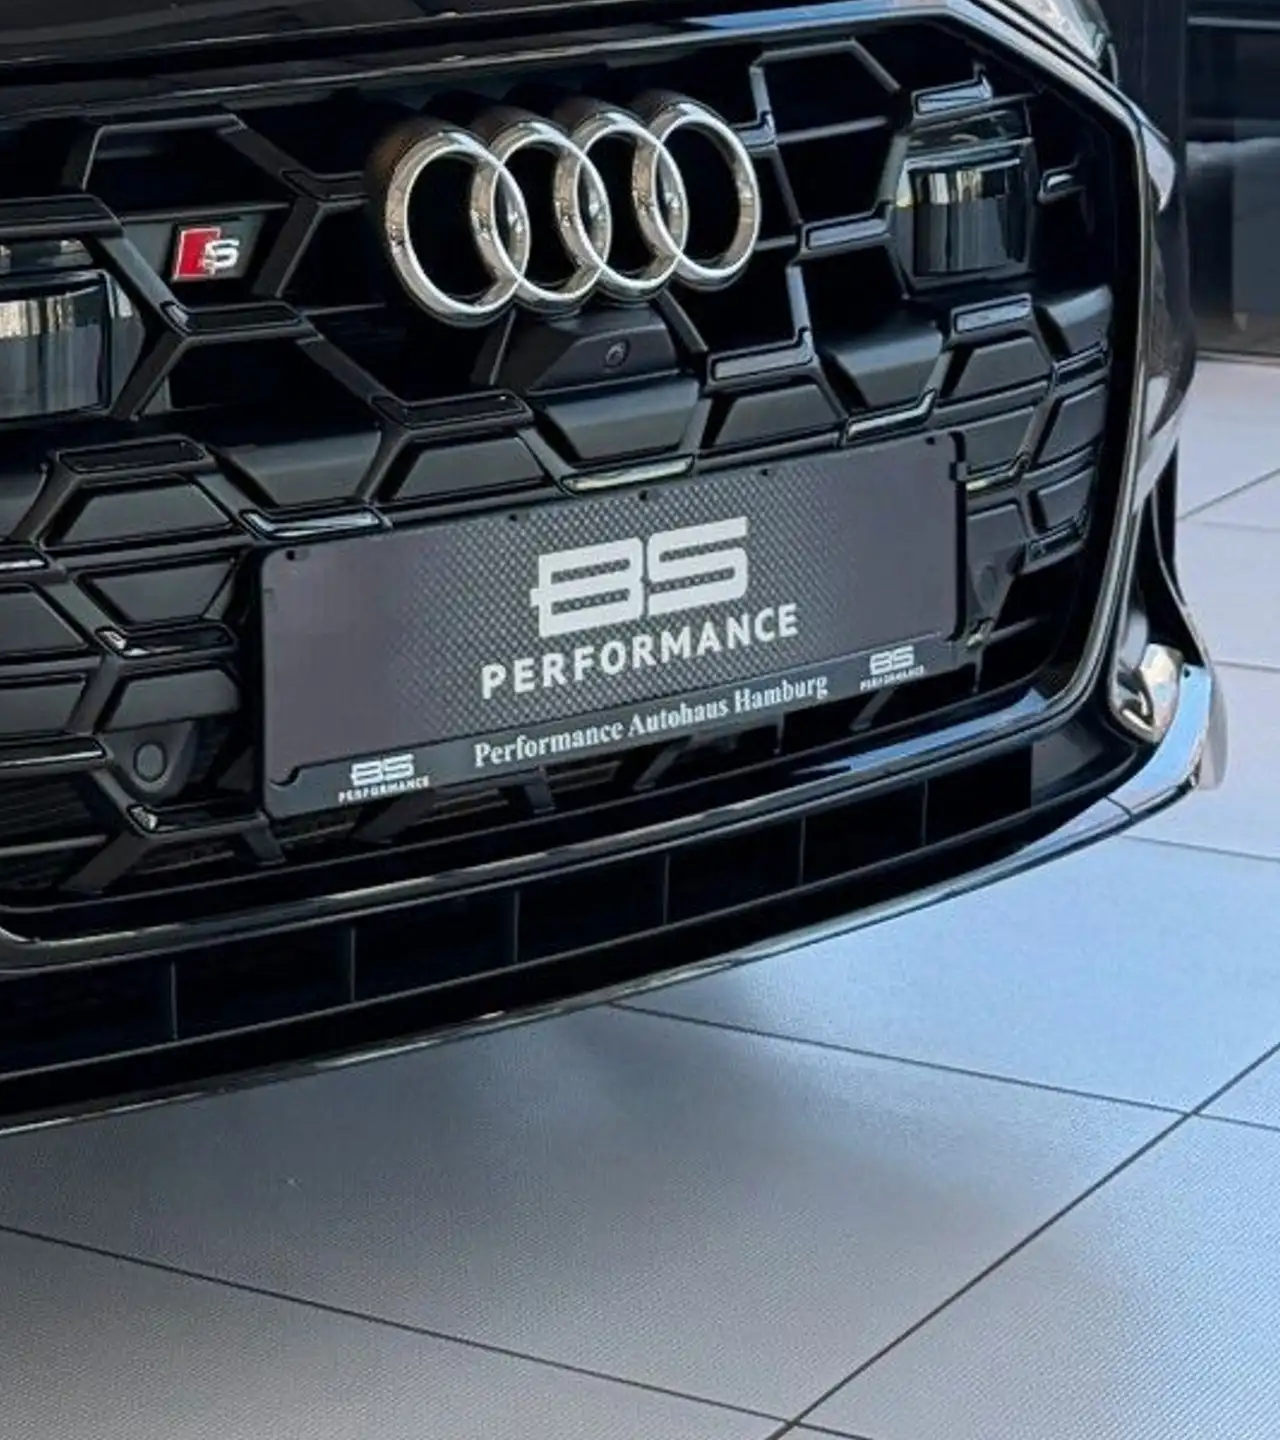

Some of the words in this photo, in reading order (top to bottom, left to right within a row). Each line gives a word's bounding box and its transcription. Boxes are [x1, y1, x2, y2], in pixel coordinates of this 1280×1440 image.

[481, 603, 798, 699] PERFORMANCE
[473, 718, 624, 768] Performance
[628, 698, 729, 737] Autohaus
[734, 675, 828, 713] Hamburg
